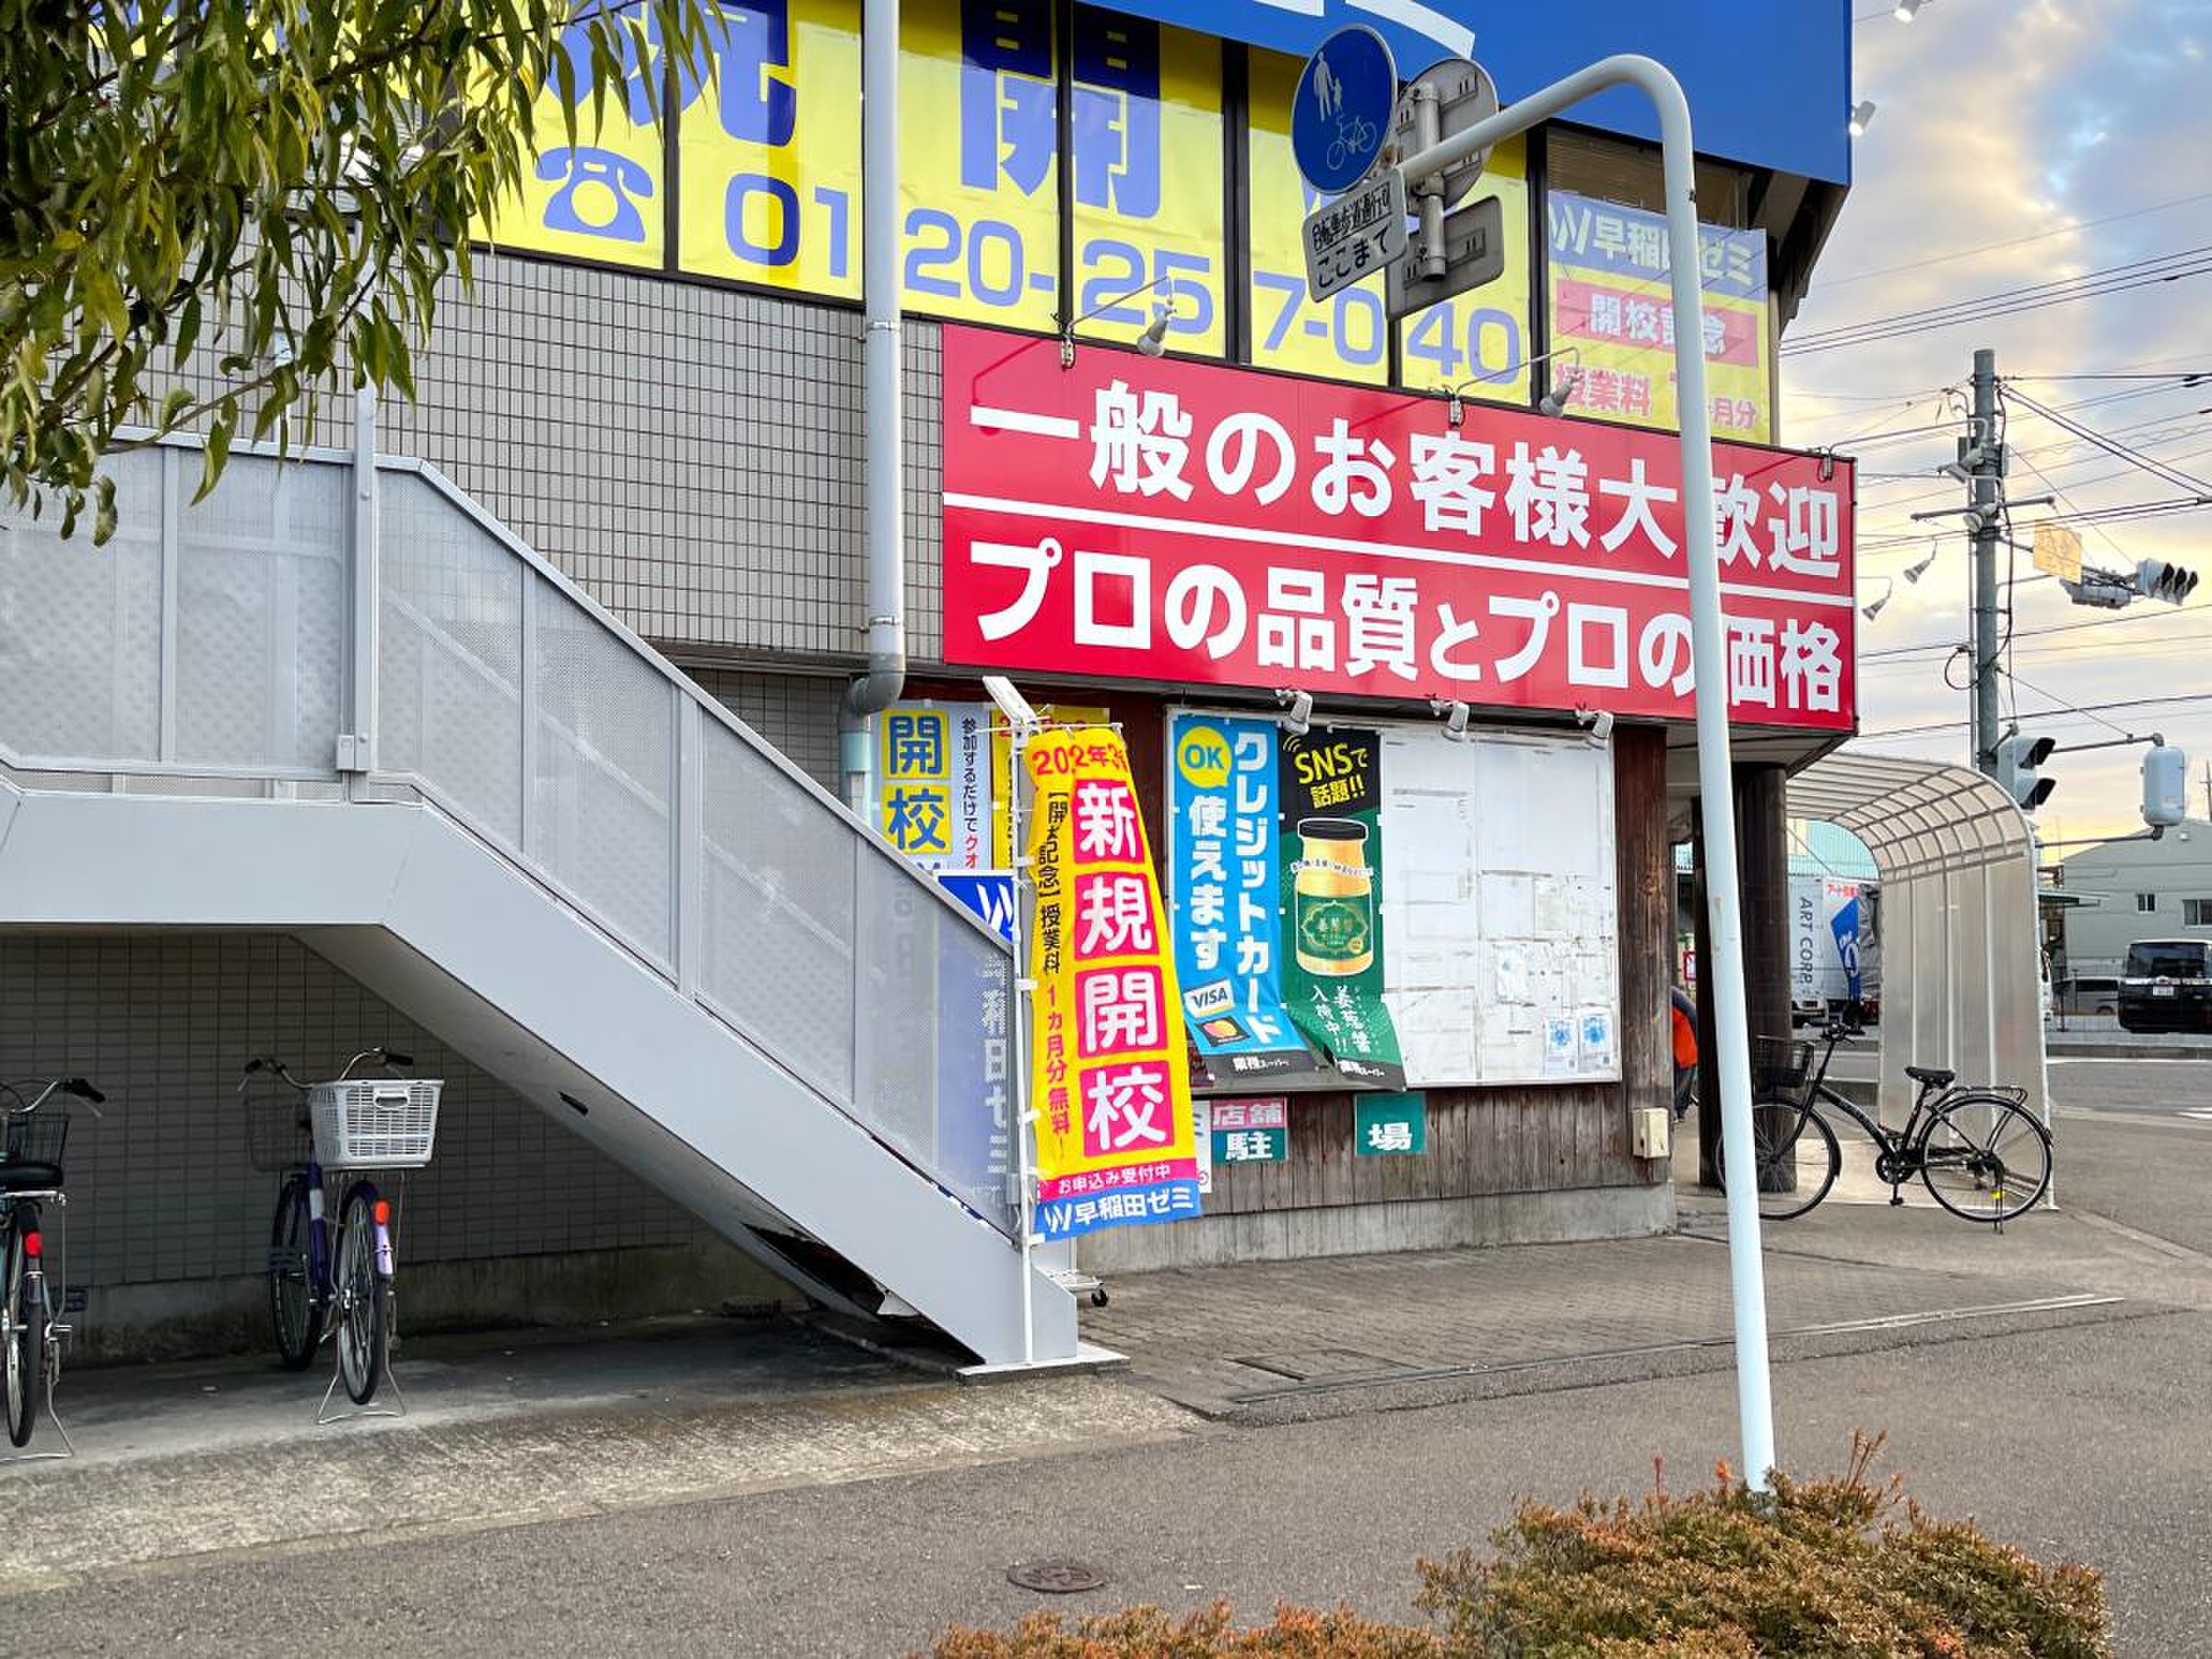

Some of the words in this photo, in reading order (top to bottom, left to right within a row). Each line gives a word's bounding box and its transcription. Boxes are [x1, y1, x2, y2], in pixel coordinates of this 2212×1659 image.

[971, 379, 1841, 578] 一般のお客様大歓迎
[970, 536, 1841, 713] プロの品質とプロの価格
[888, 715, 946, 851] 開校
[1184, 744, 1224, 770] OK
[1295, 743, 1369, 784] SNSで
[1188, 795, 1228, 971] 使えます
[1235, 732, 1282, 1044] クレジットカード
[1799, 896, 1813, 932] ART
[1076, 782, 1167, 1151] 新規開校
[1193, 987, 1228, 1009] VISA
[1059, 1164, 1171, 1194] お申込み受付中
[1368, 1121, 1412, 1151] 場
